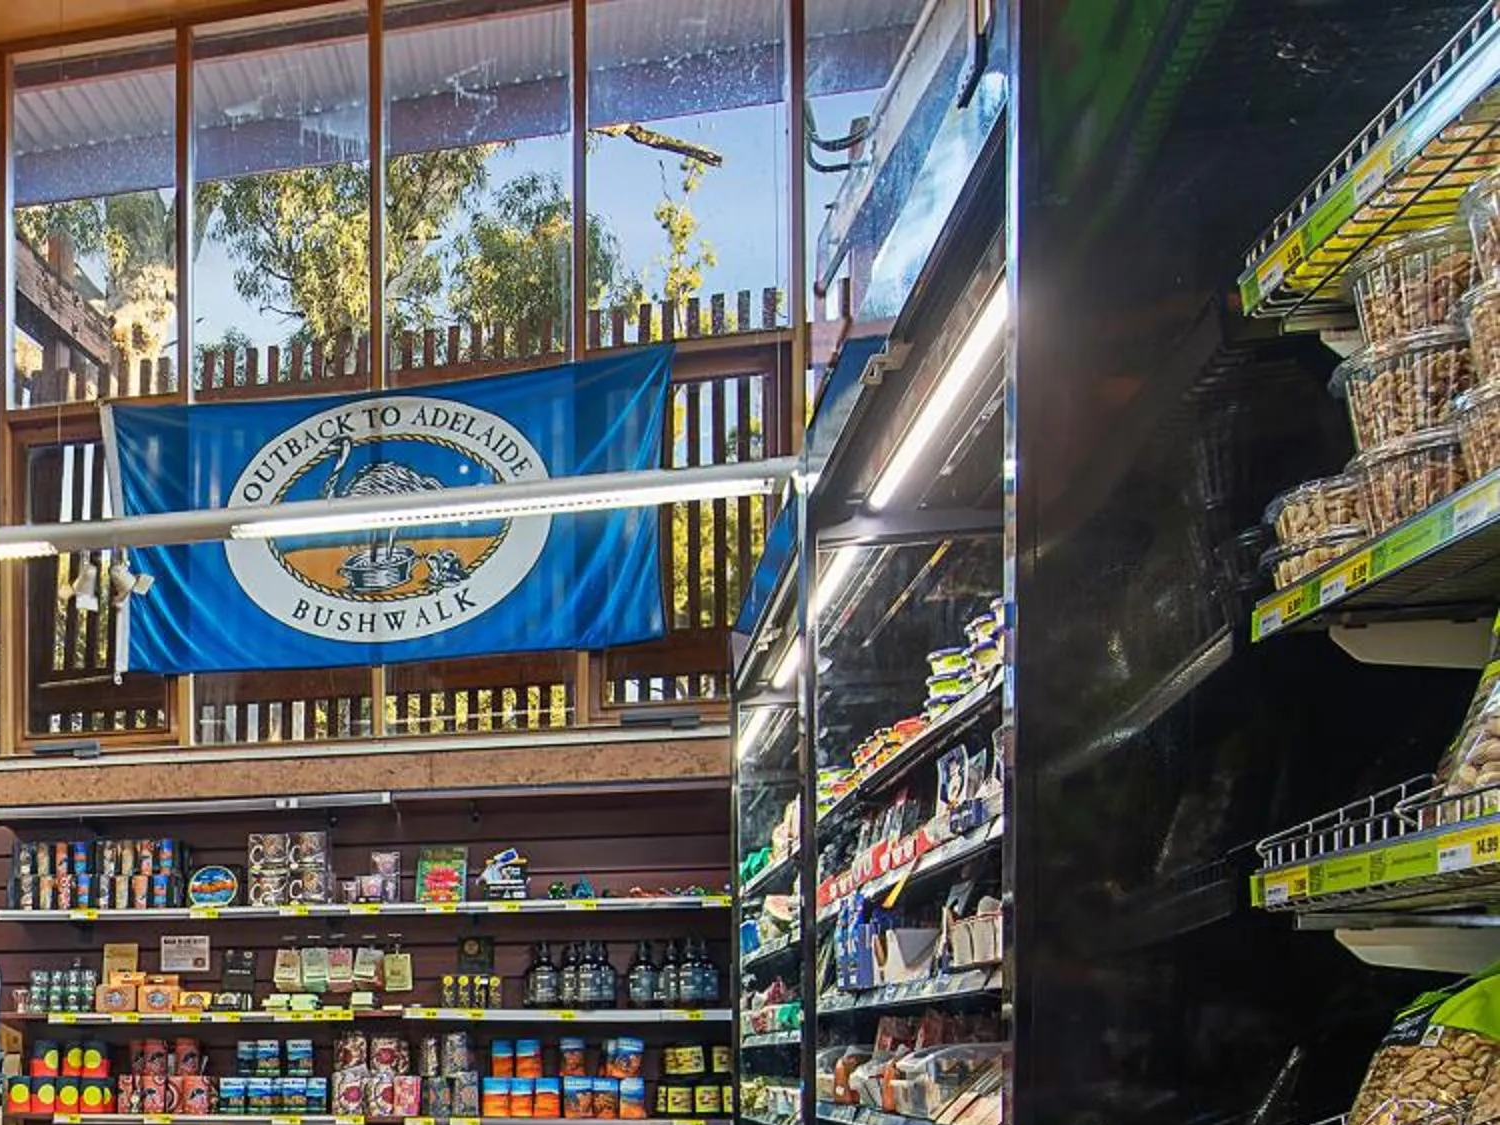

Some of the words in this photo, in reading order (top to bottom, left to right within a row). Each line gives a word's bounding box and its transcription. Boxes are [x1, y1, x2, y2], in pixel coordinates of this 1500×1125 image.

[243, 411, 356, 502] OUTBACK
[362, 405, 401, 429] TO
[411, 404, 533, 477] ADELAIDE
[292, 587, 478, 633] BUSHWALK
